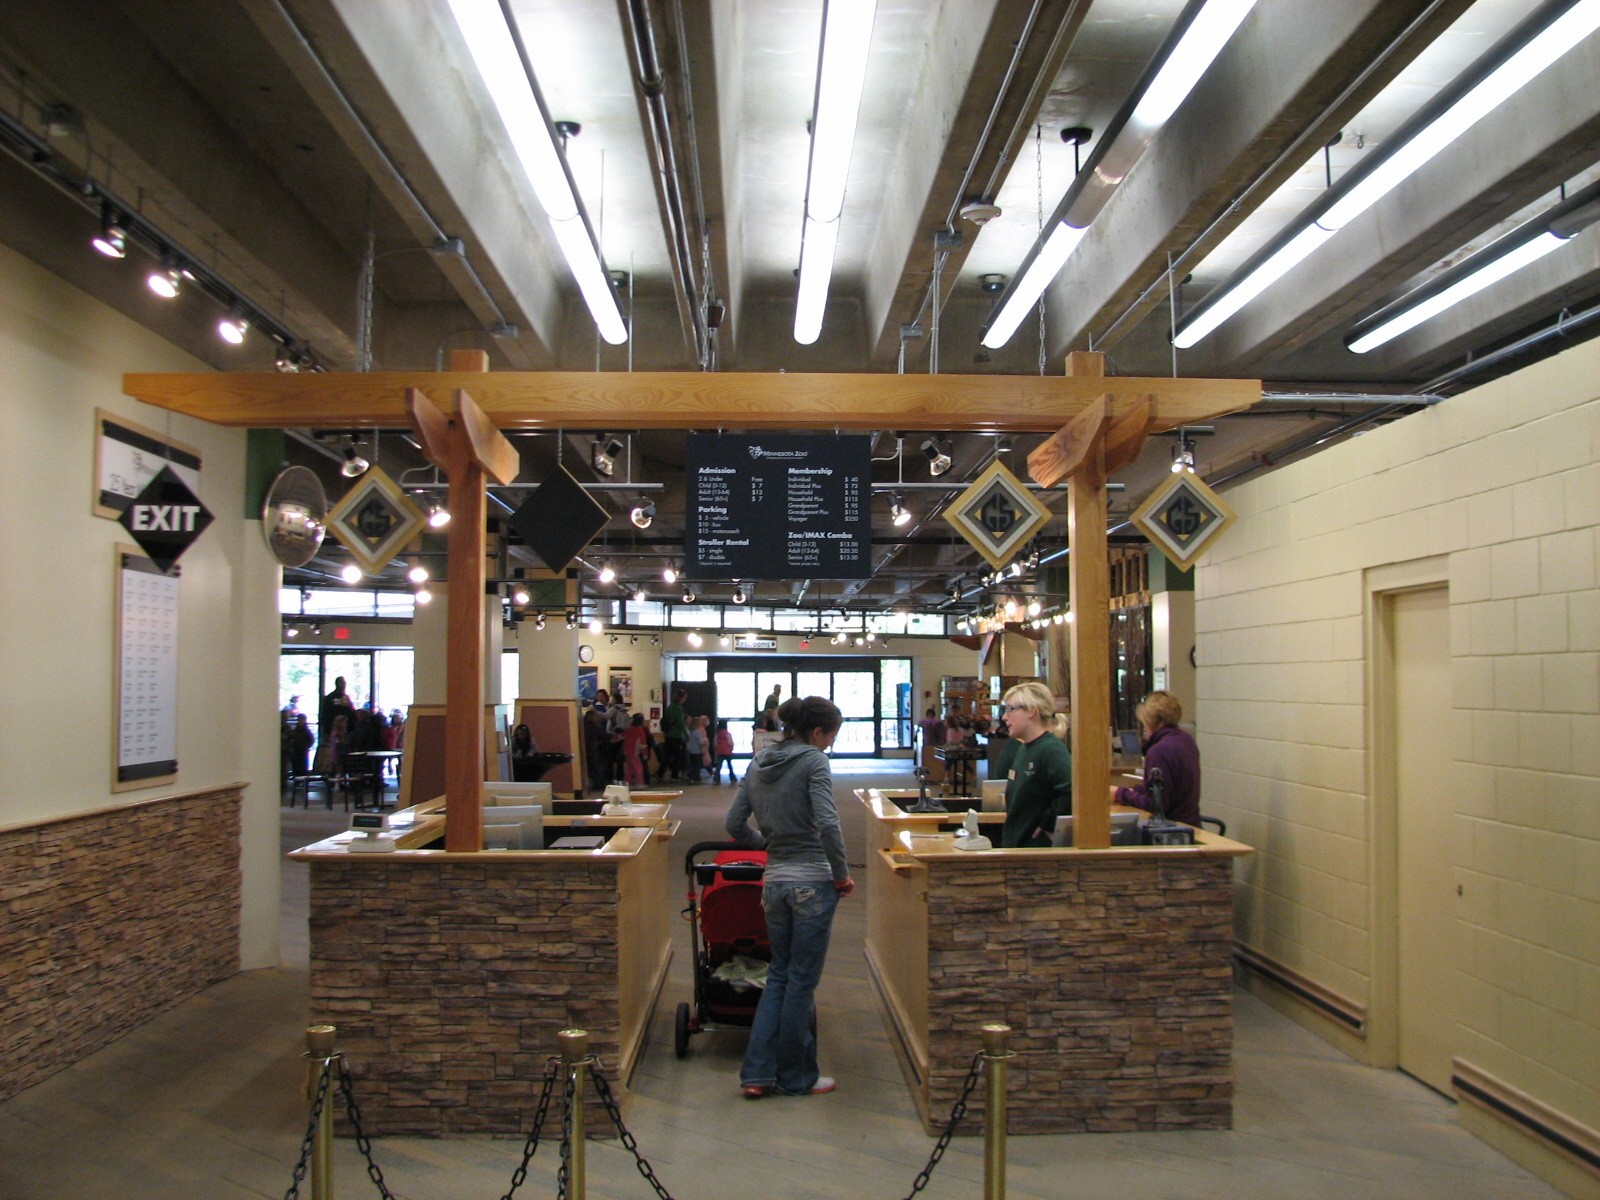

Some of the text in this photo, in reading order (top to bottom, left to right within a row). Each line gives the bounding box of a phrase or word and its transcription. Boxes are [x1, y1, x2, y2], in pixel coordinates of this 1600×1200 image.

[698, 506, 727, 514] Parking
[133, 505, 201, 532] EXIT
[736, 639, 771, 648] Resooms
